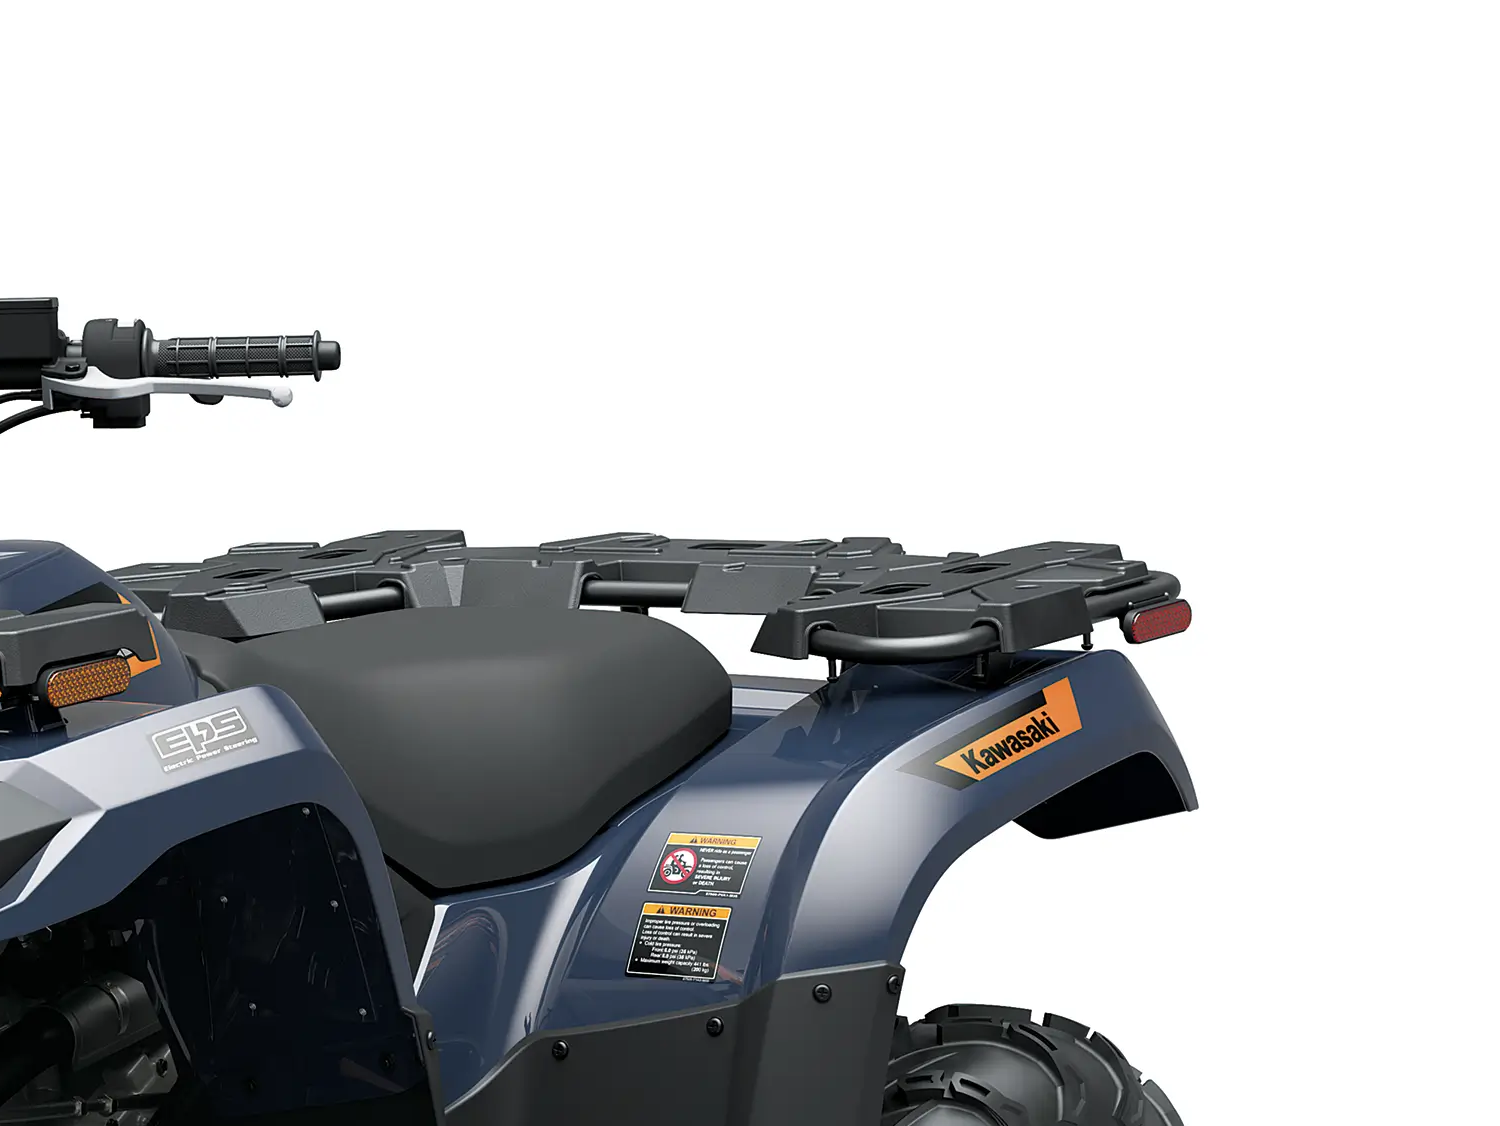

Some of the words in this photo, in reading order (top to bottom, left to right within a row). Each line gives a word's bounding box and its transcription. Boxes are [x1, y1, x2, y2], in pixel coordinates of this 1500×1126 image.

[151, 707, 248, 760] EPS
[960, 711, 1061, 775] Kawasaki
[163, 756, 195, 772] Electric
[196, 748, 222, 761] Power
[223, 737, 258, 751] Steering
[700, 837, 737, 846] WARNING
[669, 906, 717, 918] WARNING
